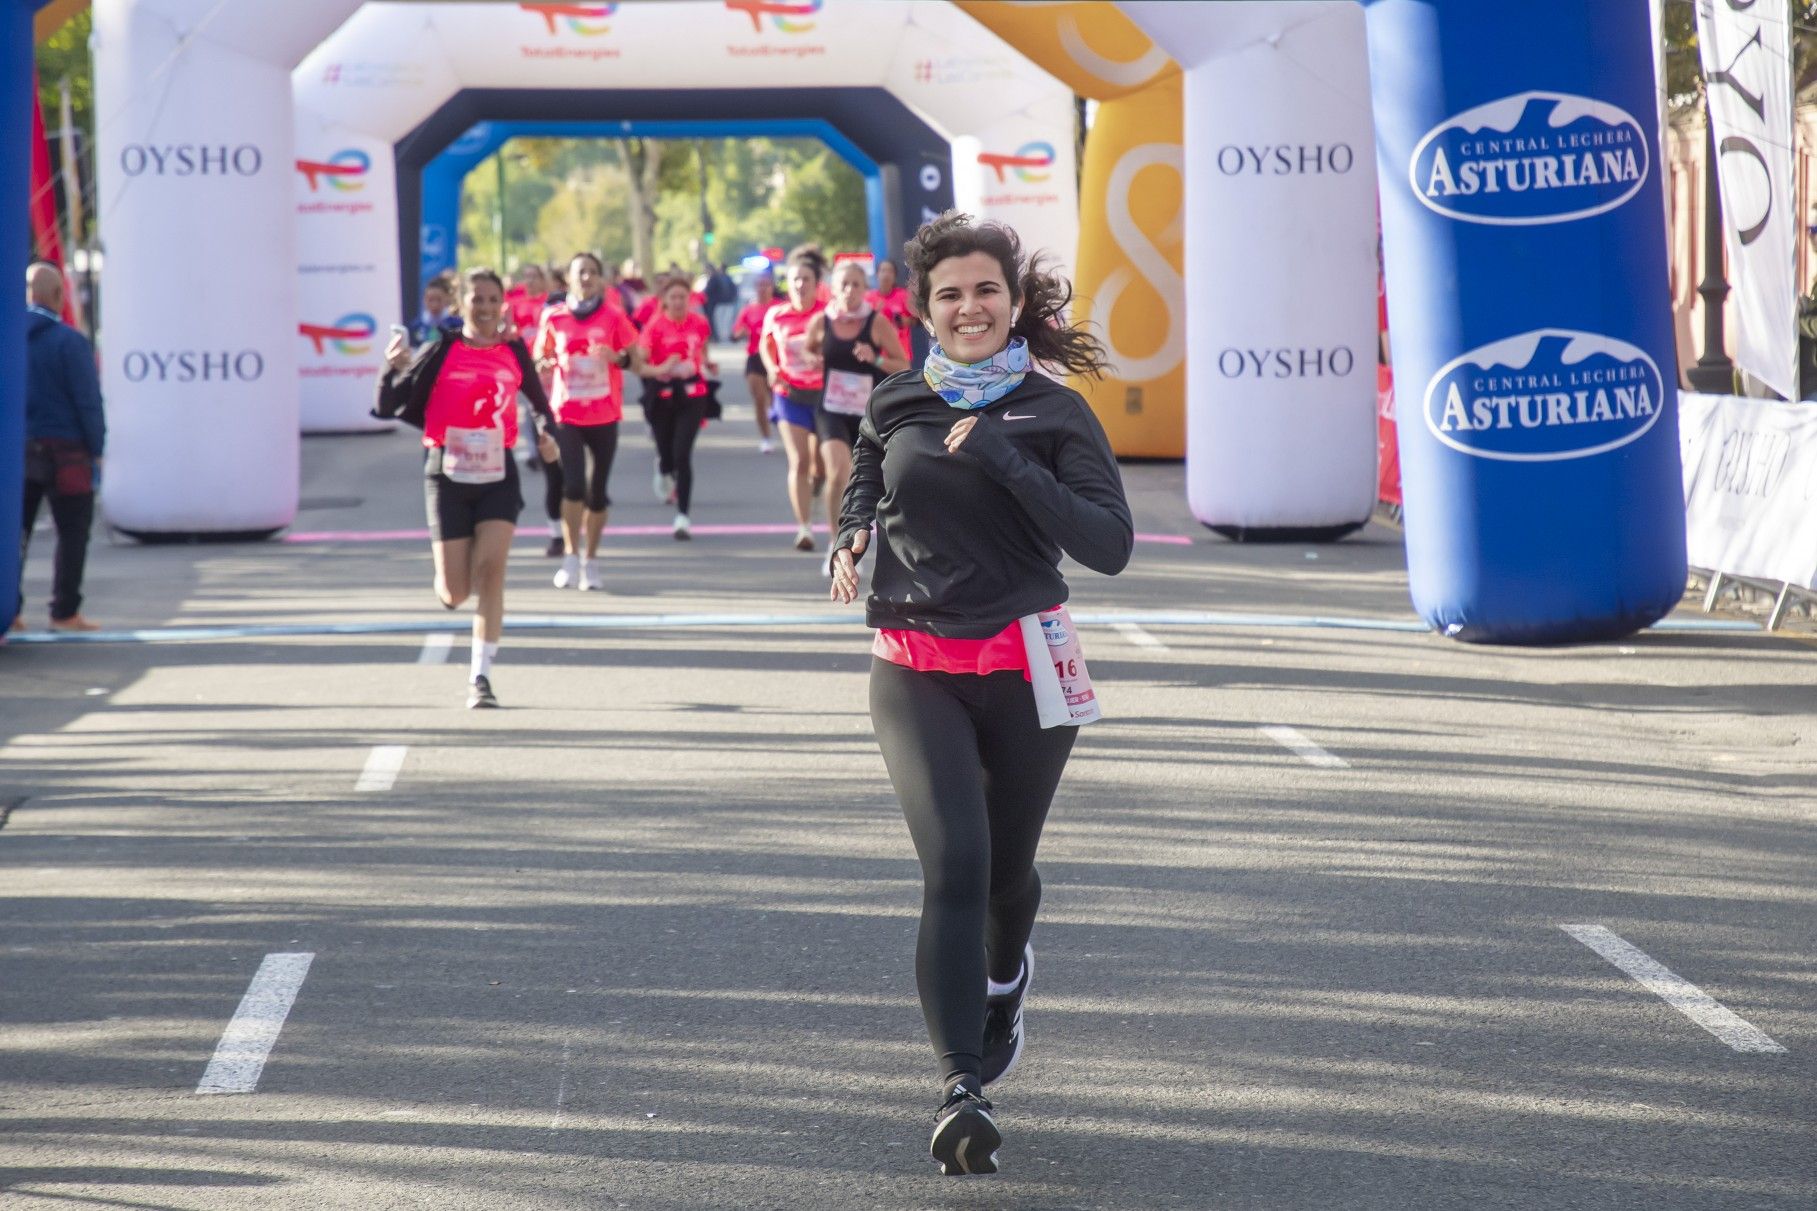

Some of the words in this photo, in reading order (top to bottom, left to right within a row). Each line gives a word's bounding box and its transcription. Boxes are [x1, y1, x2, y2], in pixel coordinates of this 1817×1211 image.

[1461, 136, 1549, 155] CENTRAL
[1558, 129, 1632, 149] LECHERA
[120, 143, 262, 177] OYSHO
[1217, 143, 1353, 176] OYSHO
[1426, 146, 1640, 196] ASTURIANA
[123, 349, 264, 382] OYSHO
[1219, 346, 1354, 378] OYSHO
[1474, 373, 1562, 392] CENTRAL
[1570, 365, 1646, 385] LECHERA
[1439, 381, 1654, 431] ASTURIANA
